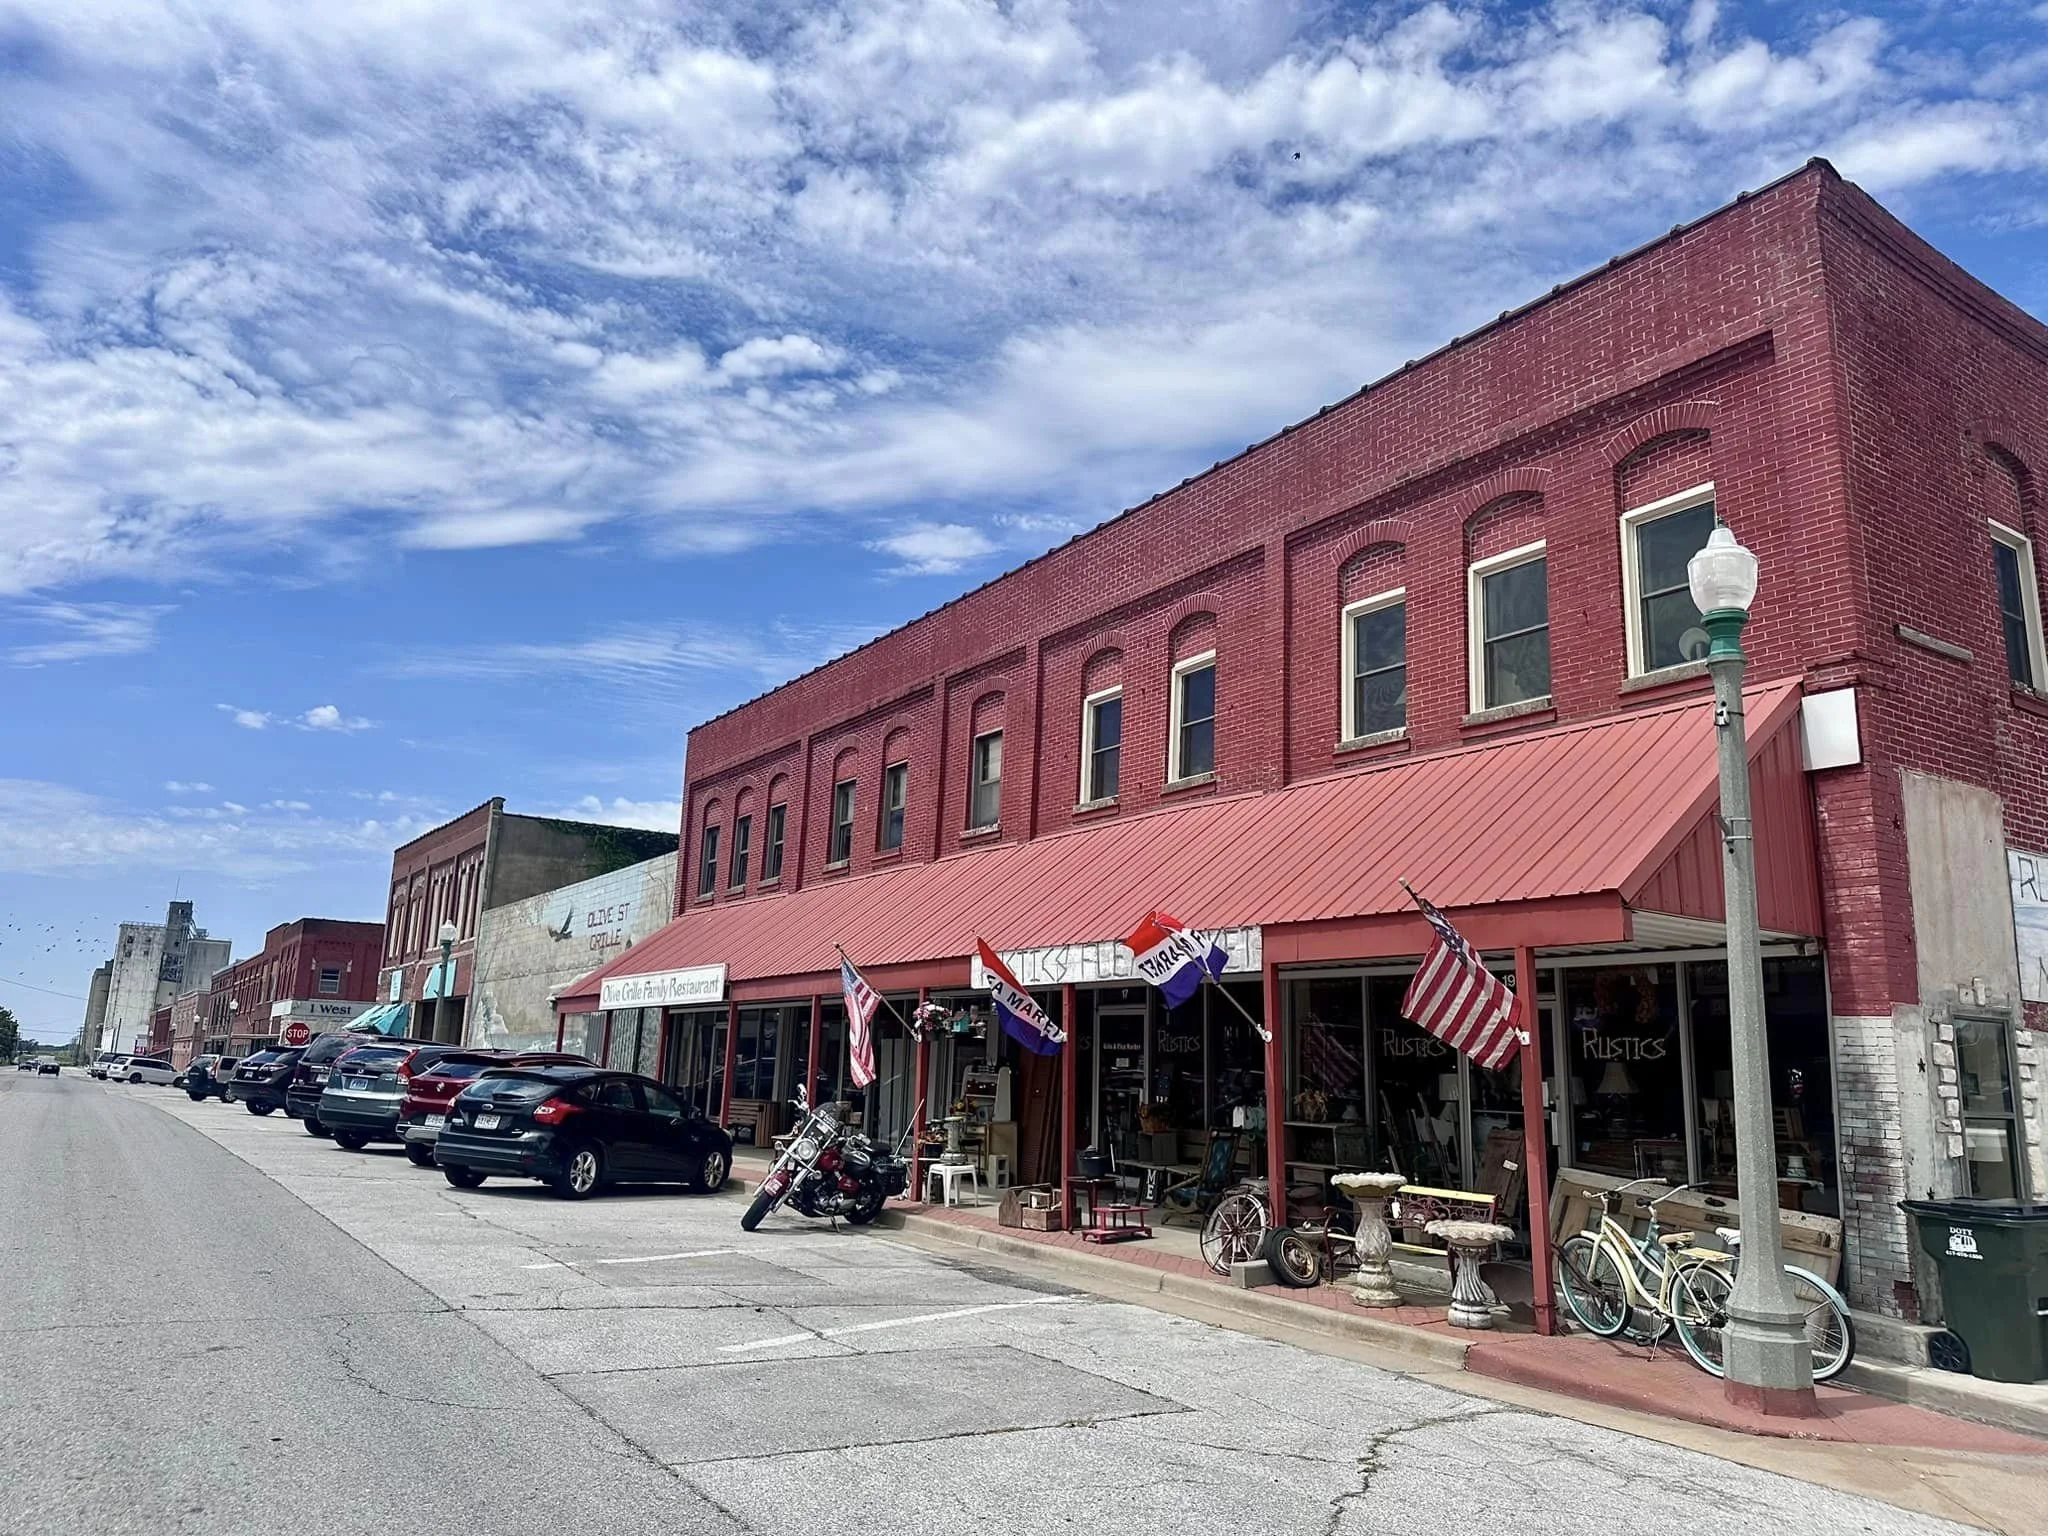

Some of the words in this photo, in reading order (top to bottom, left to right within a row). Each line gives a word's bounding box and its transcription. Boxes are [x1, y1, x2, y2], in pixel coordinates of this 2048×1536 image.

[588, 907, 613, 928] OLIVE
[618, 903, 630, 921] ST
[590, 928, 621, 950] GRILLE
[602, 984, 620, 1003] Olive
[621, 981, 641, 1001] Grille
[643, 979, 669, 1003] Family
[669, 976, 720, 998] Restaurant
[320, 1004, 352, 1015] West
[287, 1029, 309, 1039] STOP
[1582, 1026, 1667, 1060] RUSTICS
[1949, 1226, 1973, 1236] DOTY
